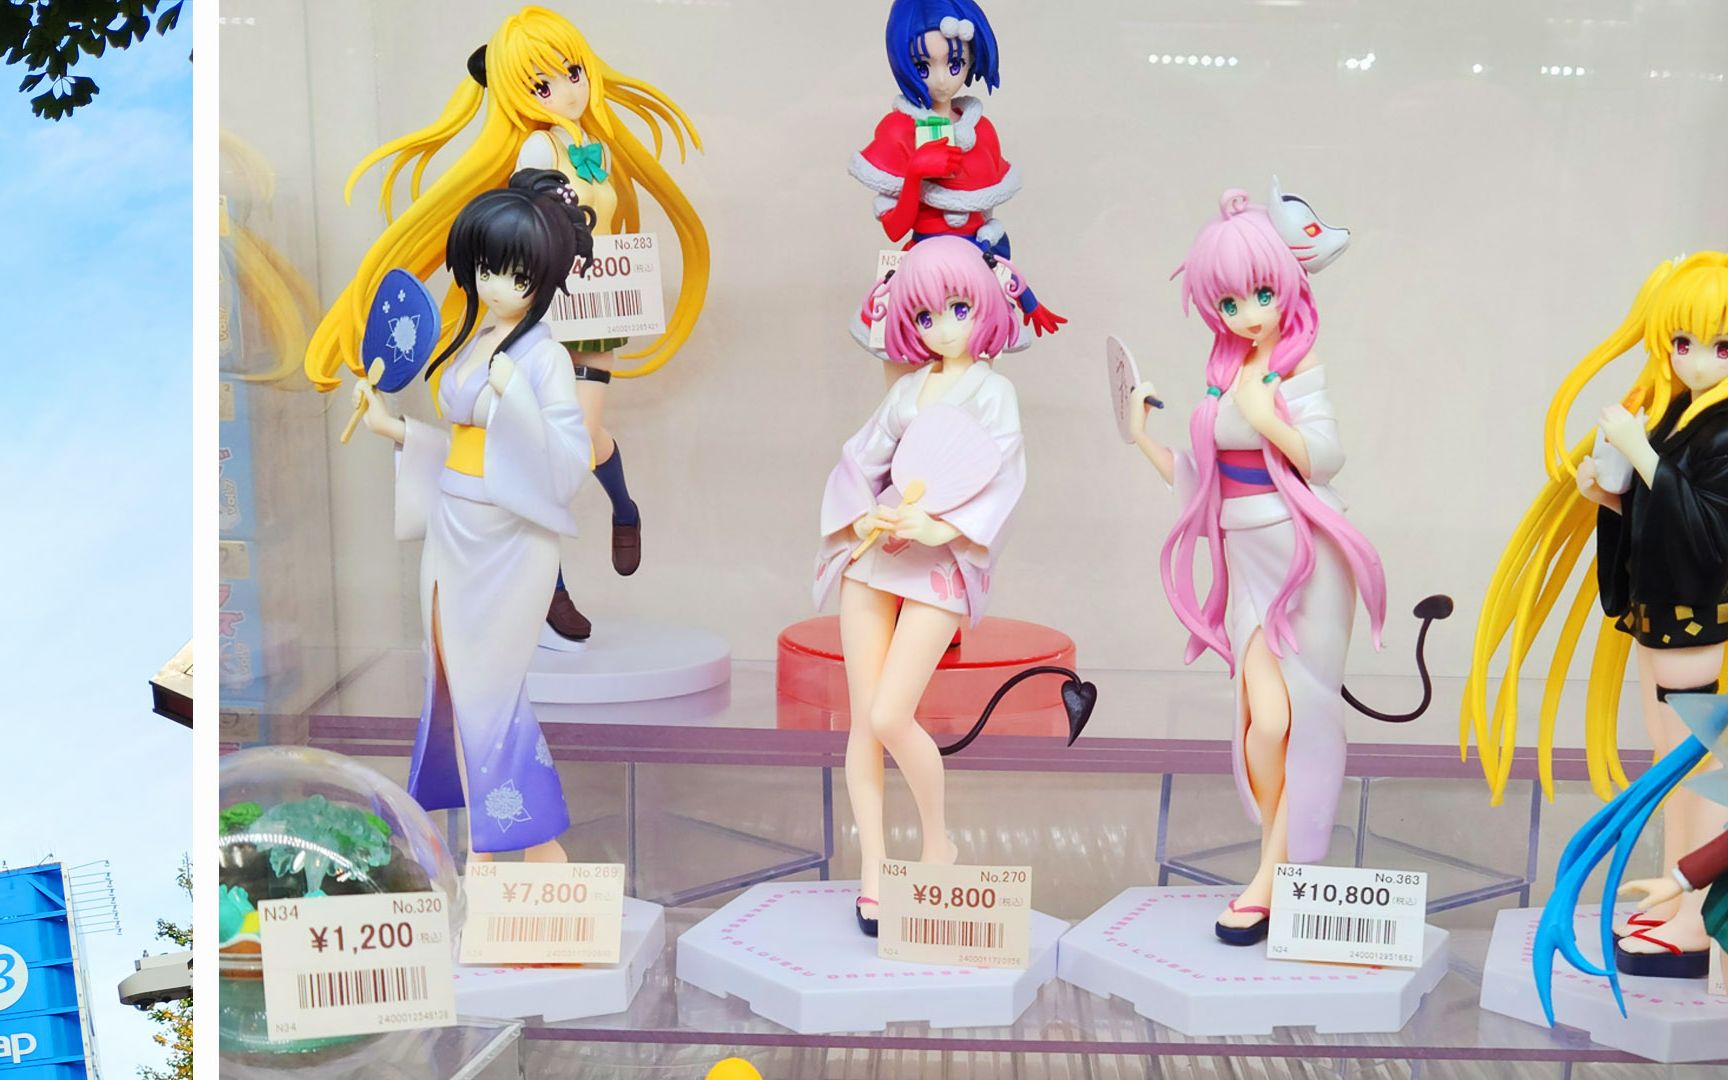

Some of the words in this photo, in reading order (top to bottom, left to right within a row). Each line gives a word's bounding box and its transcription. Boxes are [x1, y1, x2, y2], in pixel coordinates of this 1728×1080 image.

[614, 237, 653, 251] No.283
[472, 865, 497, 877] N34
[882, 864, 907, 877] N34
[980, 871, 1027, 883] No.270
[1277, 866, 1303, 878] N34
[1375, 872, 1420, 886] No.363
[502, 882, 588, 906] ¥7,800
[913, 883, 996, 909] ¥9,800
[1292, 881, 1391, 907] ¥10,800
[265, 904, 299, 921] N34
[392, 898, 442, 914] No.320
[309, 921, 414, 955] ¥1,200
[276, 1023, 297, 1032] N34
